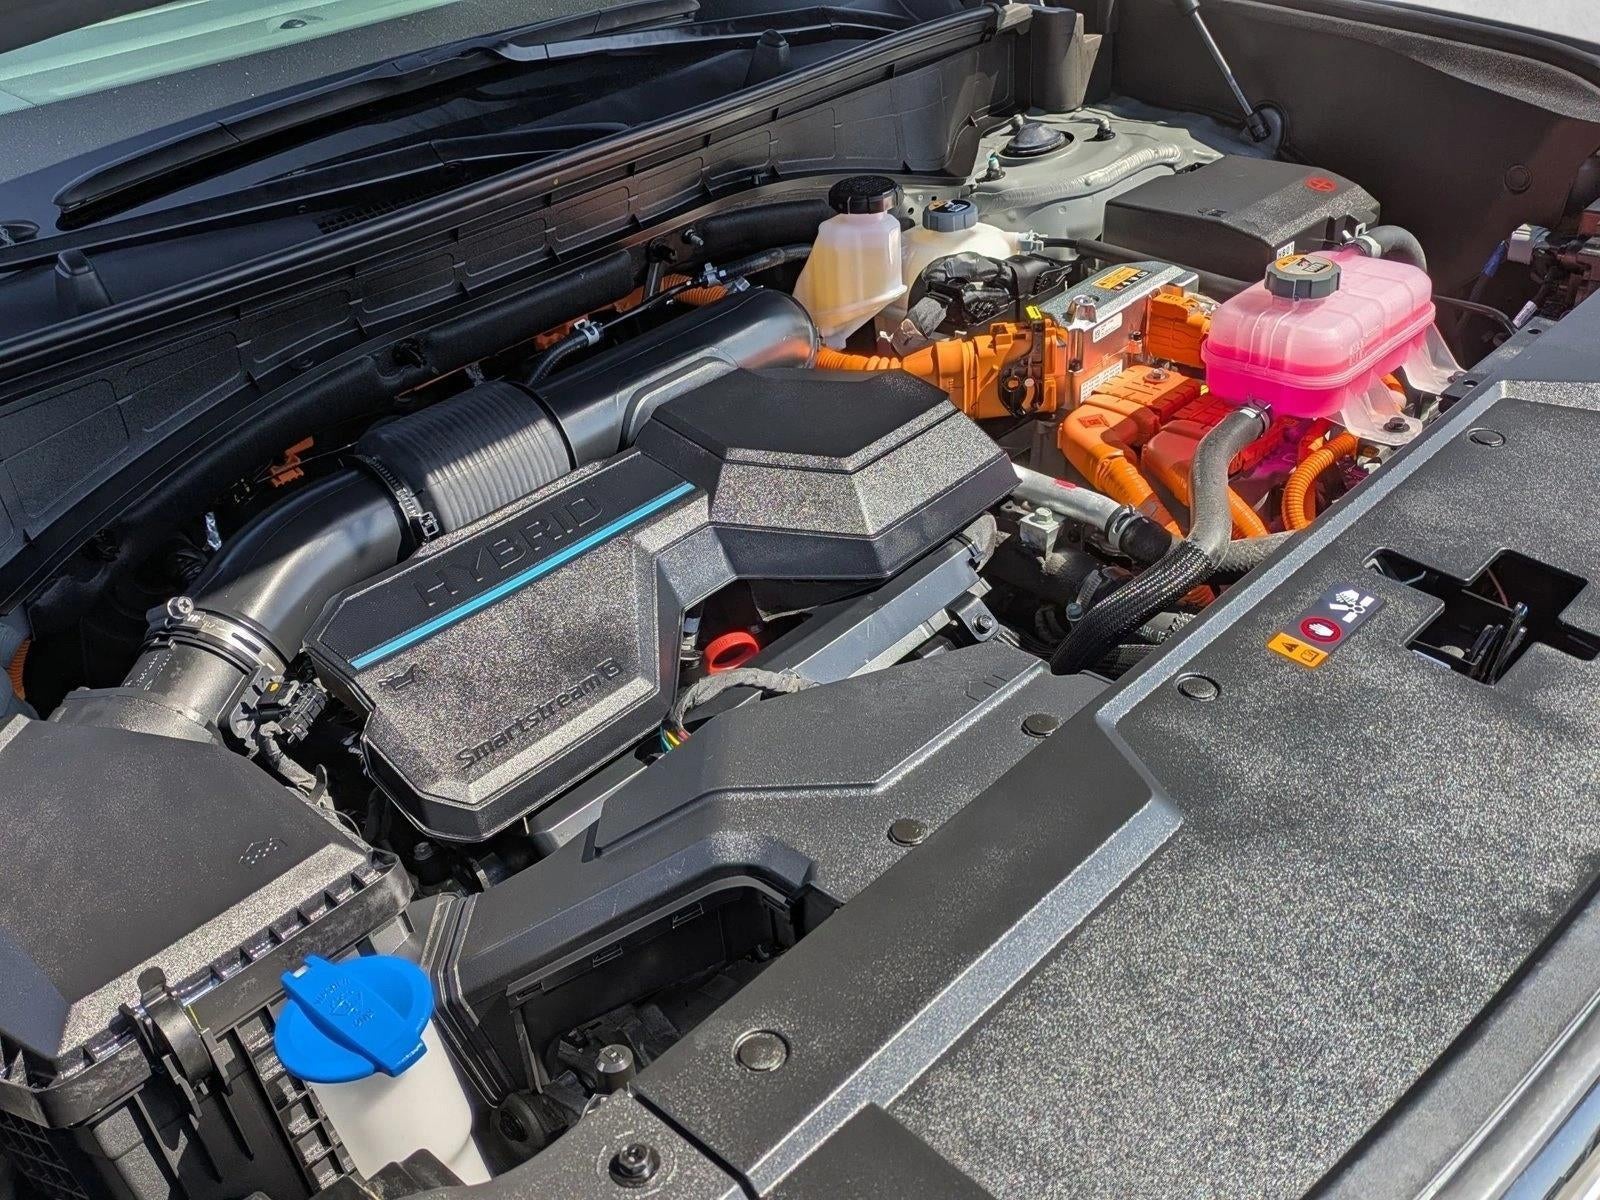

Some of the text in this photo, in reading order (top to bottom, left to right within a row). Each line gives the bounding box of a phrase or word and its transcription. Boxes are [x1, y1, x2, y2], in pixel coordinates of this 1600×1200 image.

[416, 497, 605, 606] HYBRID
[456, 657, 623, 768] Smartstream G
